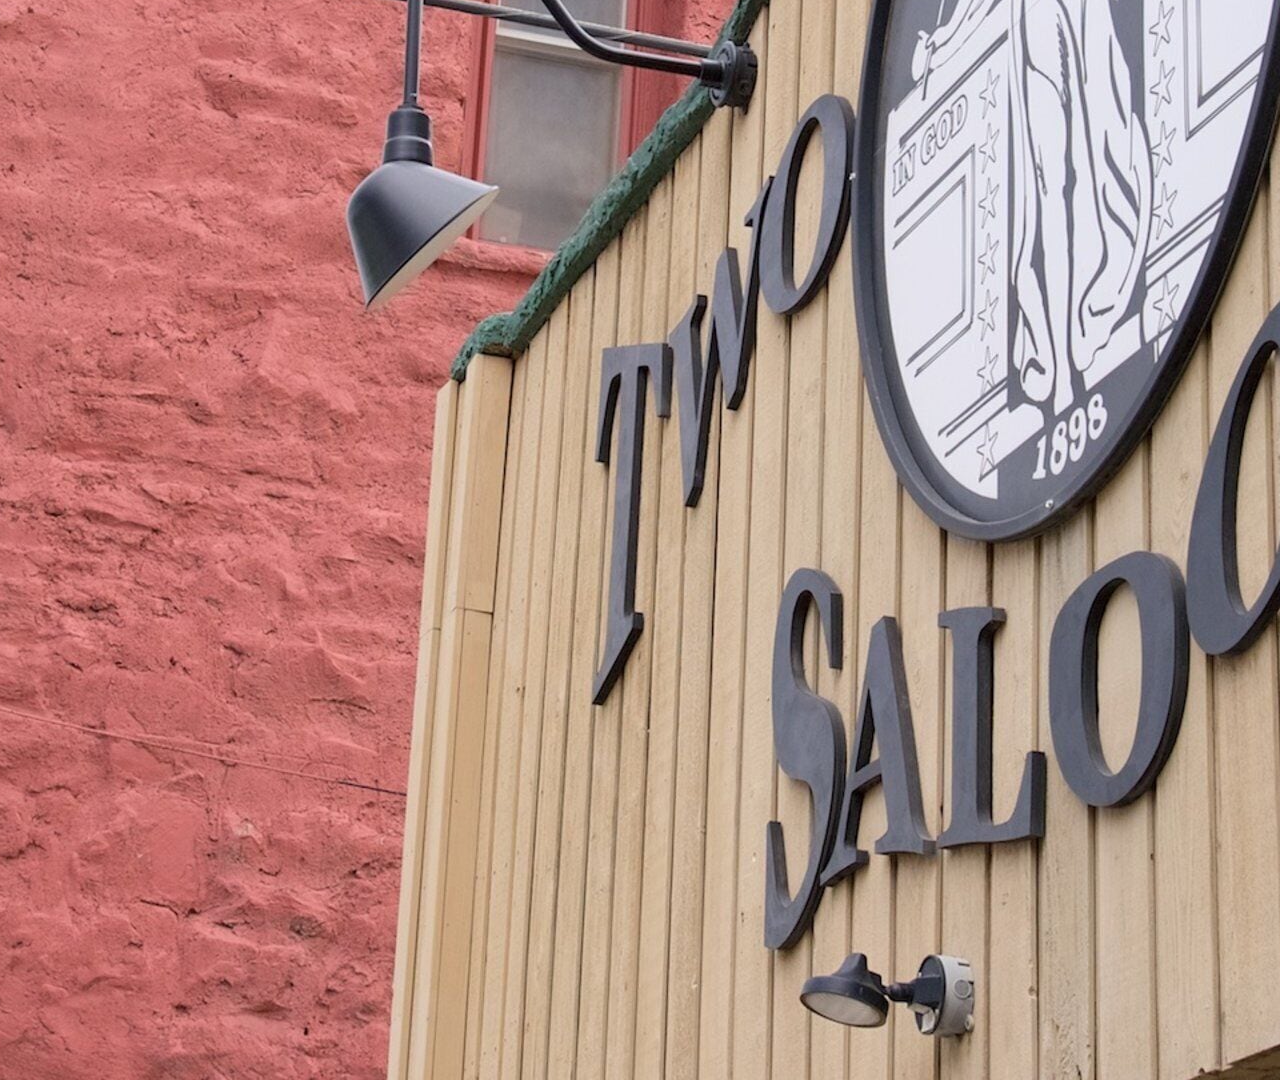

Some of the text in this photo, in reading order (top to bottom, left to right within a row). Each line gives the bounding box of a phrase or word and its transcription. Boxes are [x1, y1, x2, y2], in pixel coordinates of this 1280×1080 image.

[892, 94, 969, 198] IN GOD
[592, 94, 854, 706] TWO
[1032, 392, 1108, 480] 1898
